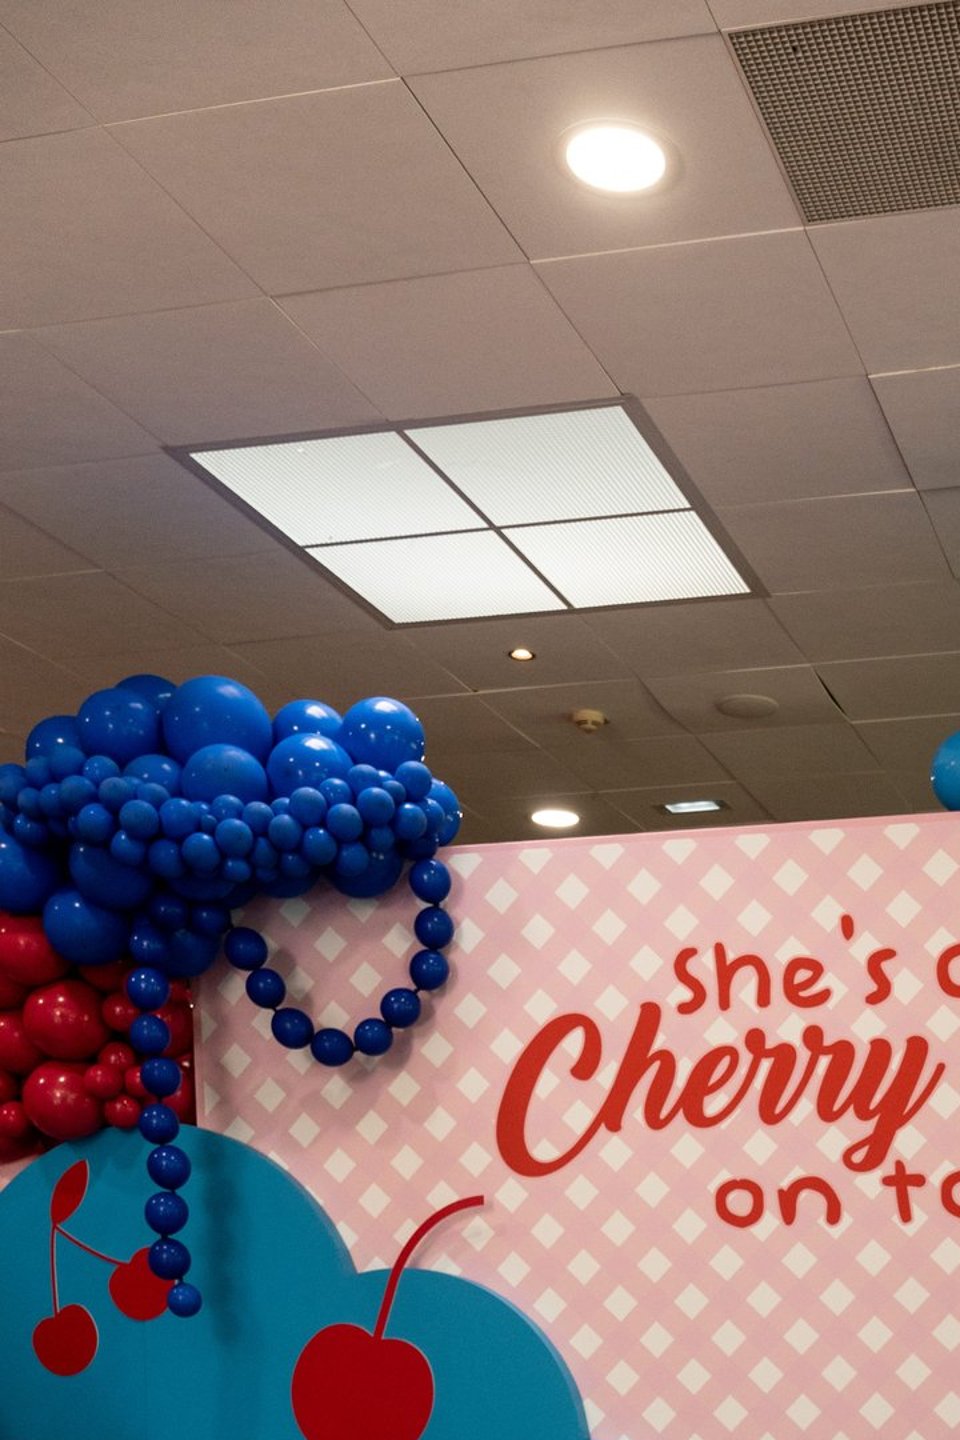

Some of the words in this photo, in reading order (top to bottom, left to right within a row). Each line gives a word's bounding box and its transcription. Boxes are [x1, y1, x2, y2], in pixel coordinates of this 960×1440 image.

[673, 913, 898, 1015] she's
[496, 1001, 946, 1177] Cherry
[715, 1175, 842, 1228] on
